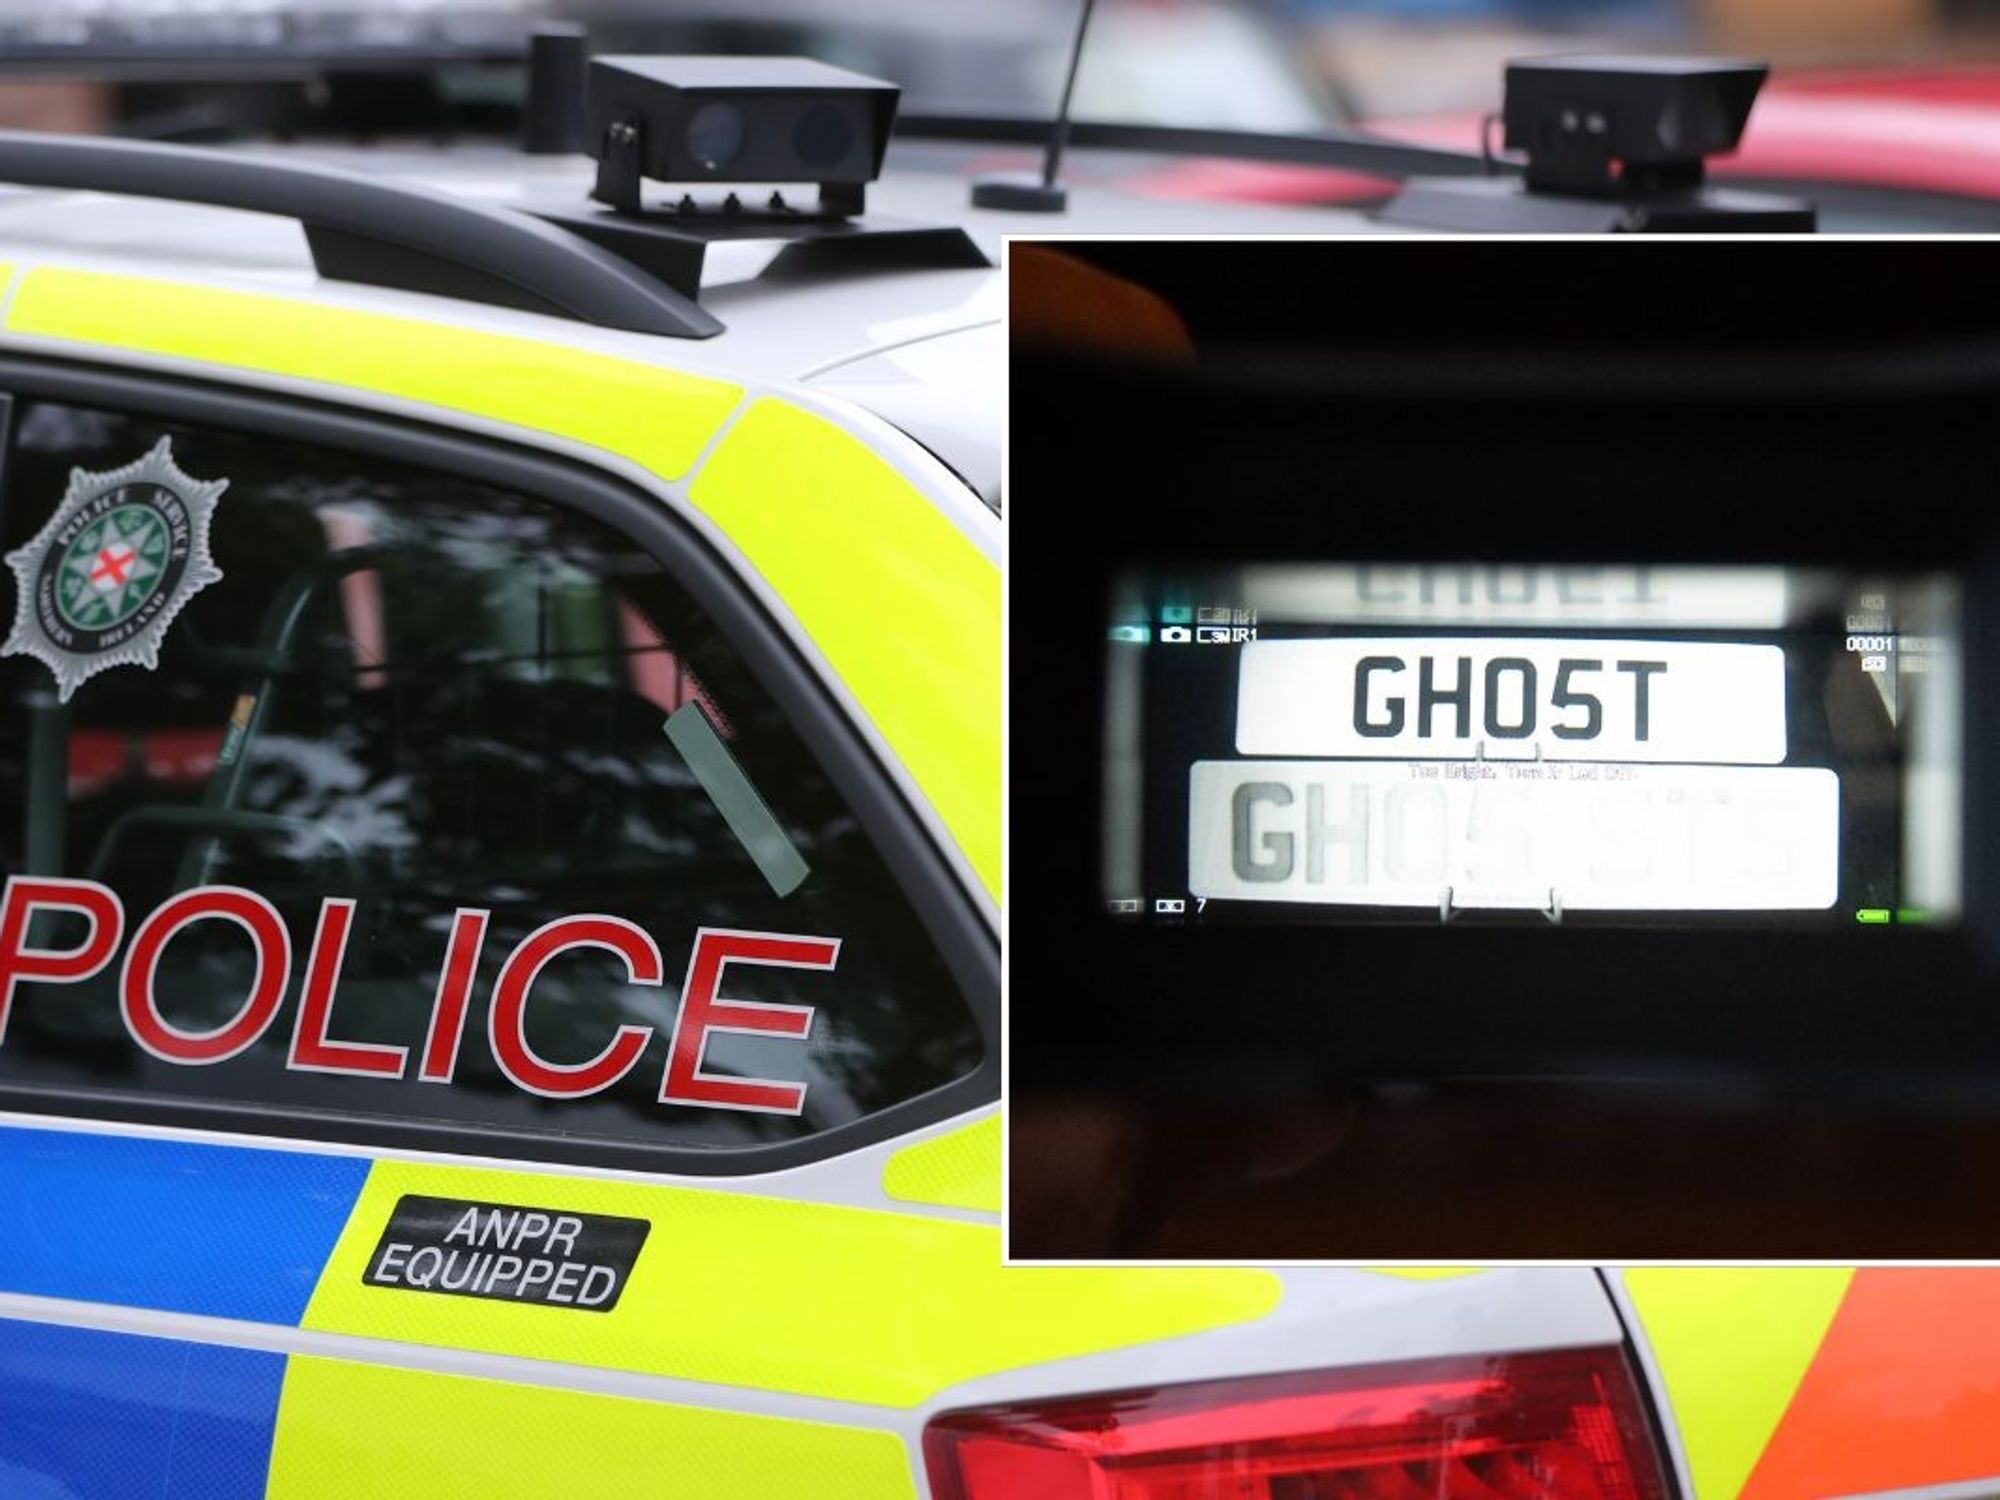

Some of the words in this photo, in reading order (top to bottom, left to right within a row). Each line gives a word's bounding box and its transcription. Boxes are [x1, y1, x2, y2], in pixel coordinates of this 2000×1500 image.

[1846, 637, 1892, 652] 00001
[0, 874, 842, 1116] POLICE
[443, 1206, 583, 1256] ANPR
[373, 1242, 617, 1306] EQUIPPED
